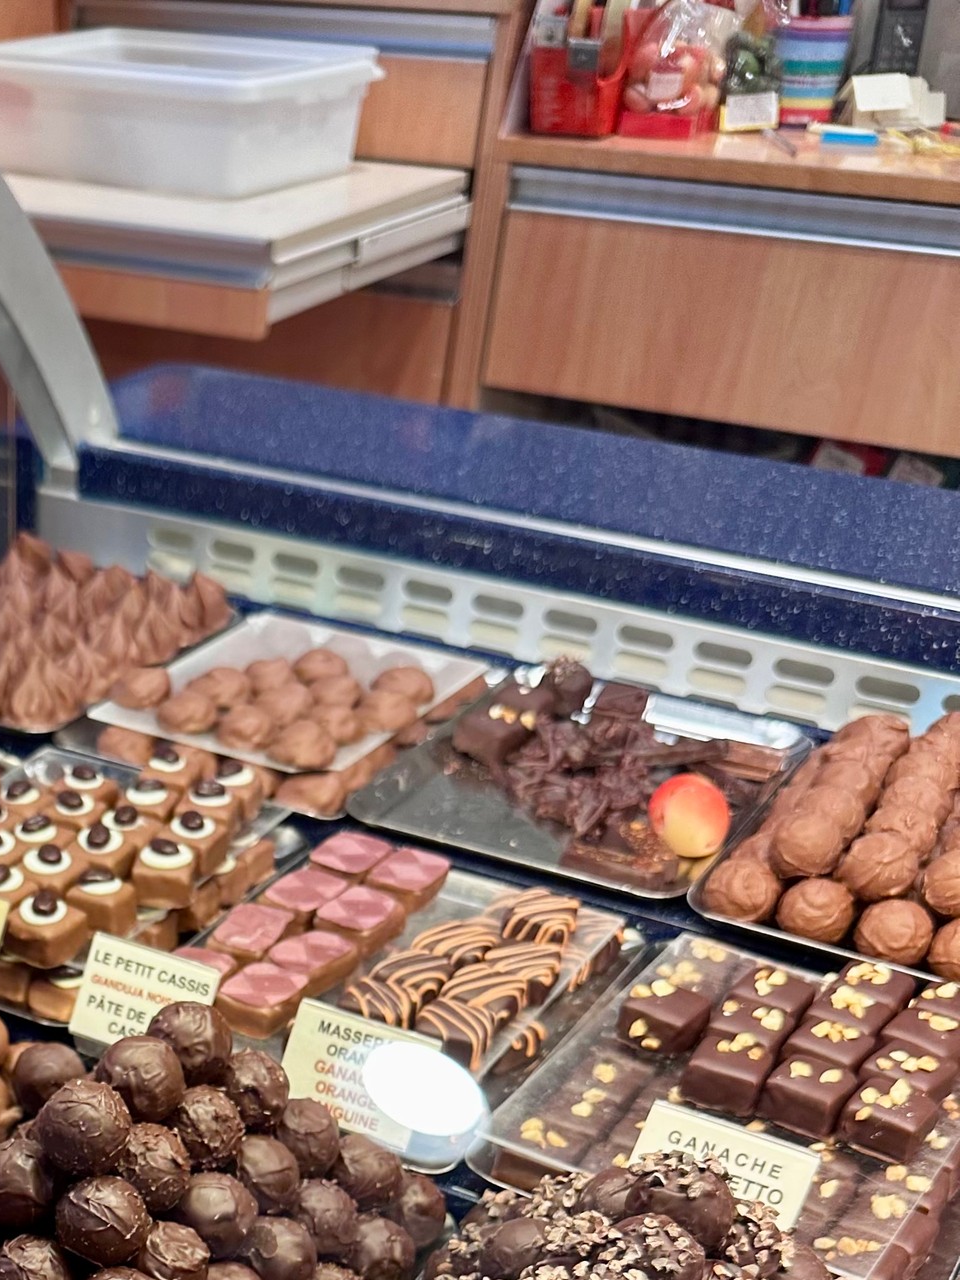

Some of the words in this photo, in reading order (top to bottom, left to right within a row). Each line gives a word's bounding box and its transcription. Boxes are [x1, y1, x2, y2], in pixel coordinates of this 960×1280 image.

[90, 973, 144, 999] GIANDUJA
[93, 949, 113, 966] LE
[114, 956, 156, 979] PETIT
[157, 970, 211, 997] CASSIS
[87, 994, 123, 1018] PÂTE
[126, 1007, 147, 1025] DE
[326, 1043, 367, 1065] ORAN
[667, 1129, 785, 1180] GANACHE
